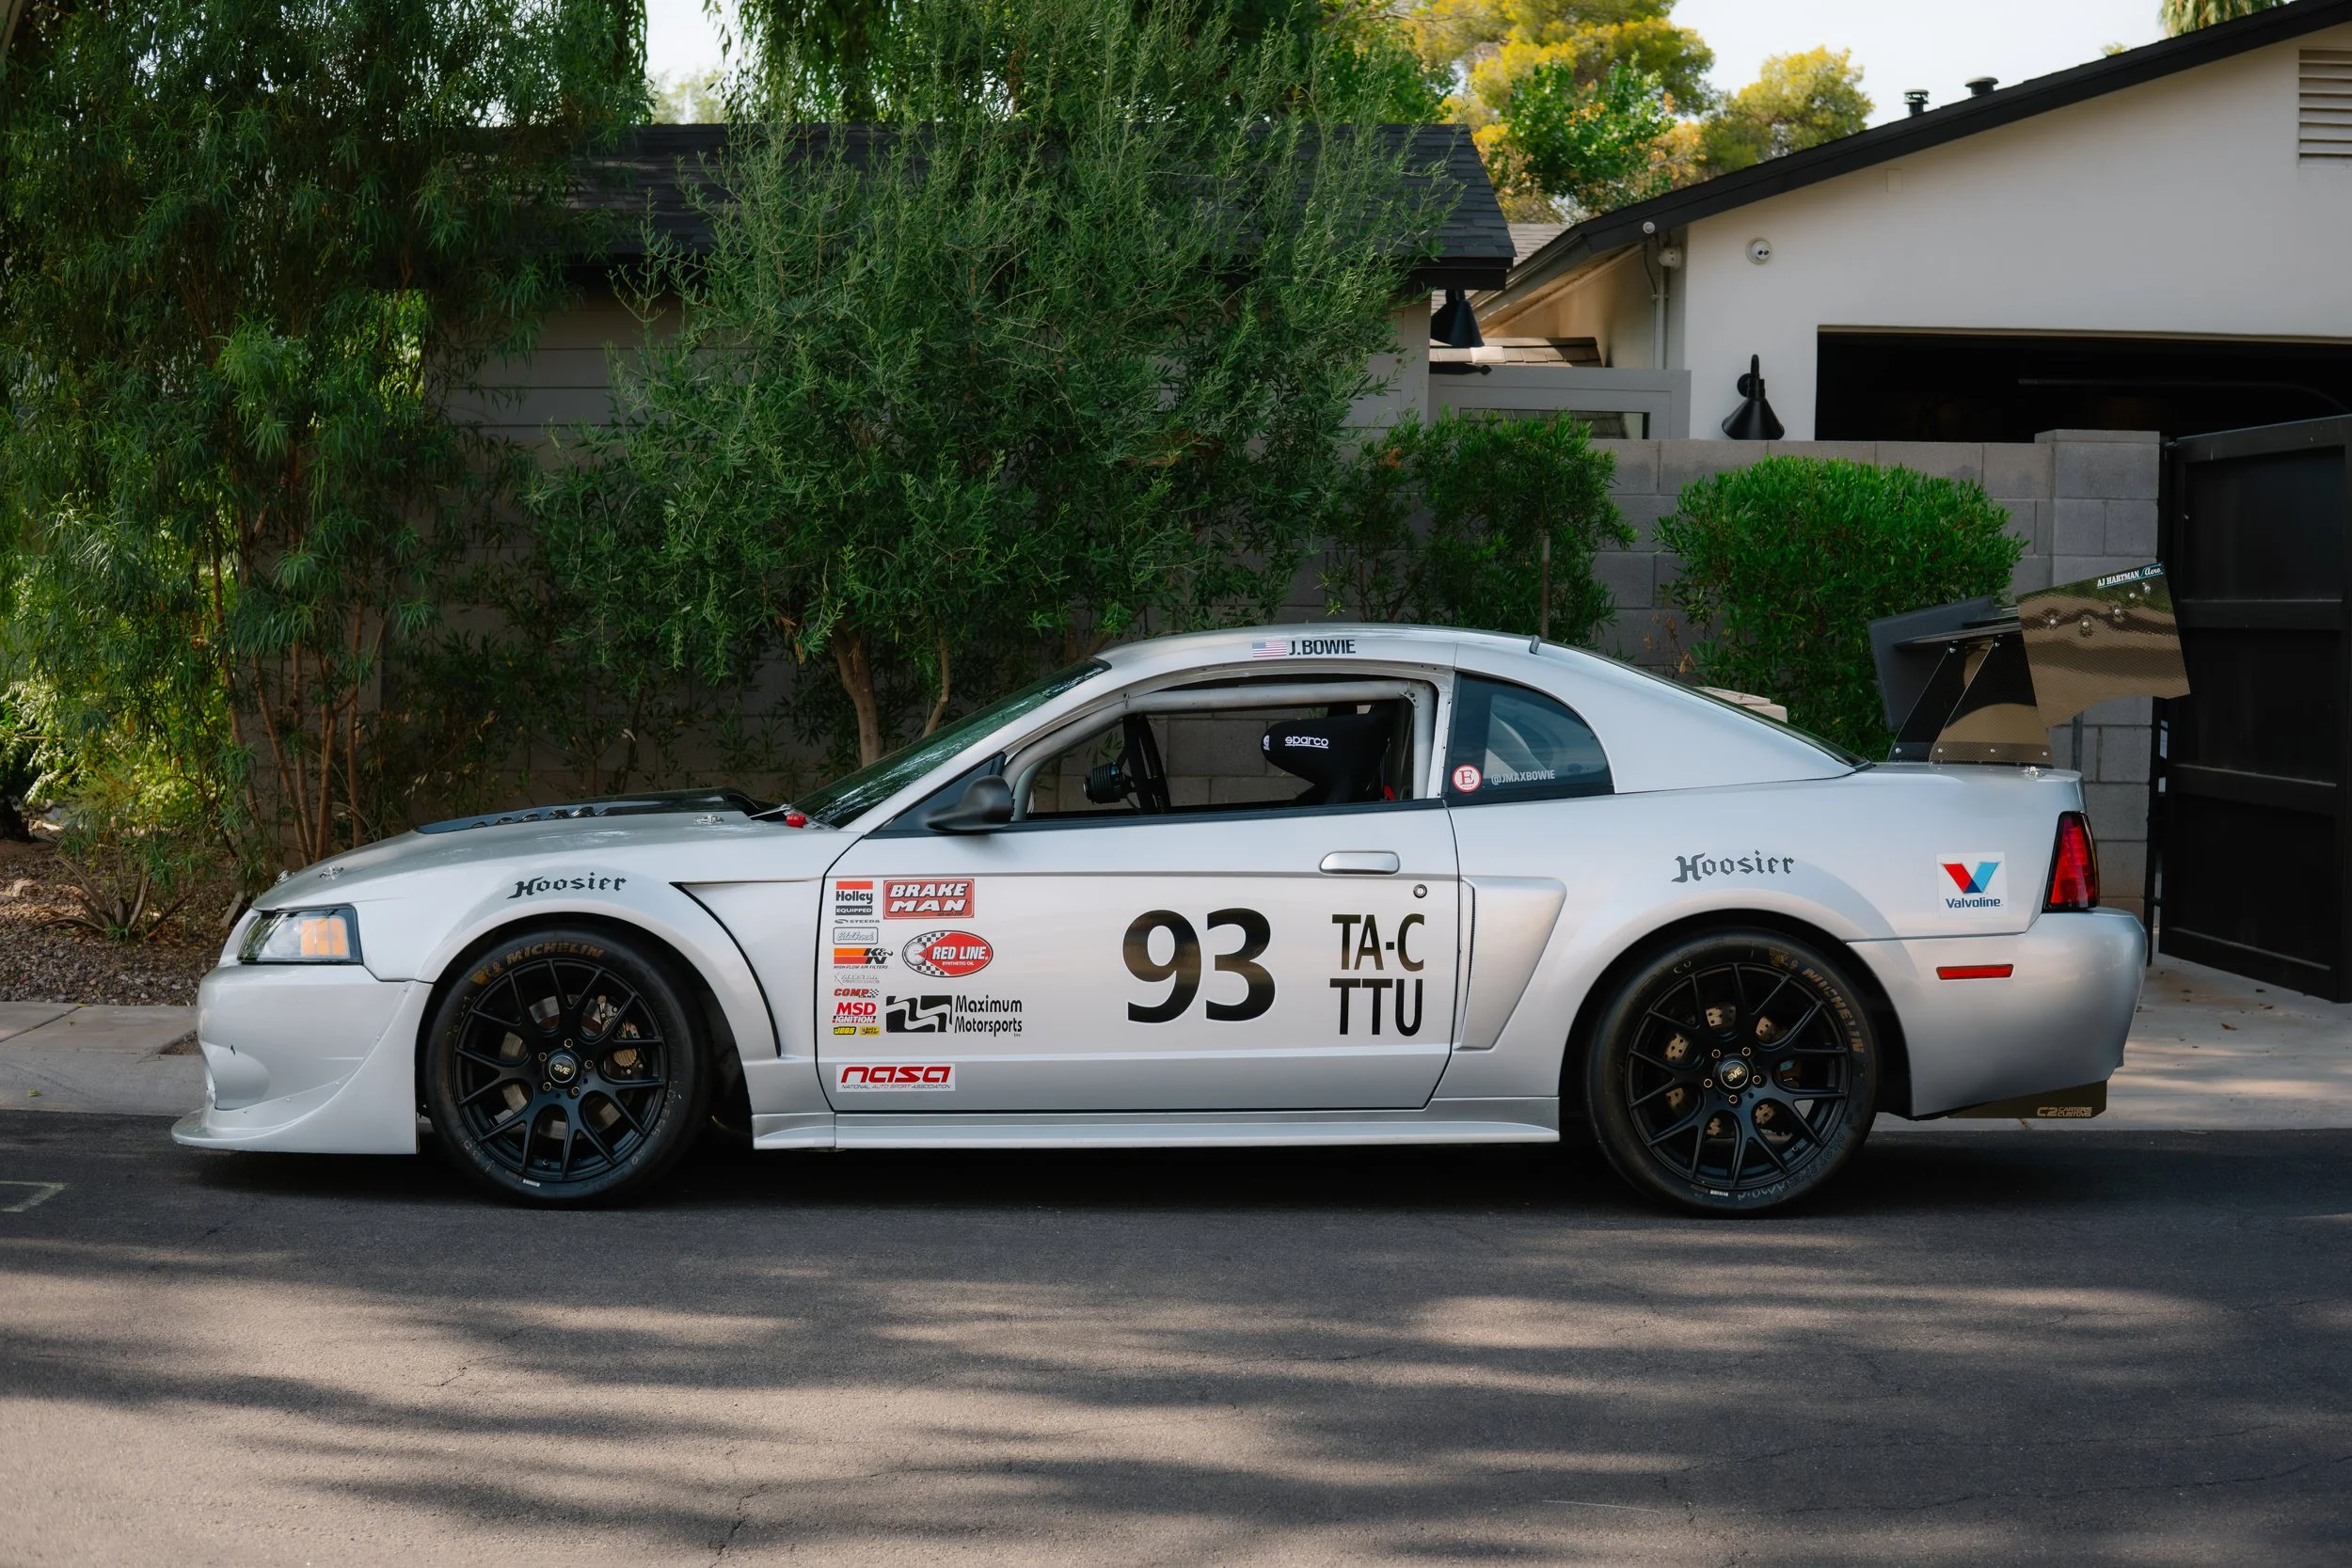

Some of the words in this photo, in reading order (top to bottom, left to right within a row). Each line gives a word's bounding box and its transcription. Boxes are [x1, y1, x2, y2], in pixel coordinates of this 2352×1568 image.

[2097, 578, 2106, 588] AJ
[2106, 571, 2139, 584] HARTMAN
[1289, 639, 1356, 656] J.BOWIE
[1284, 736, 1329, 748] sparco
[1491, 769, 1556, 785] @JMAXBOWIE
[1671, 849, 1795, 883] Hoosier
[506, 871, 627, 899] Hoosier
[889, 883, 969, 898] BRAKE
[835, 890, 874, 905] Holley
[1946, 896, 2001, 909] Valvoline
[889, 899, 967, 913] MAN
[1331, 912, 1425, 973] TA-C
[506, 942, 604, 964] MICHELIN
[931, 945, 957, 960] RED
[959, 945, 987, 960] LINE
[1122, 908, 1277, 1023] 93
[834, 988, 870, 997] COMP
[835, 1002, 877, 1016] MSD
[955, 994, 1023, 1013] Maximum
[1329, 977, 1423, 1037] TTU
[1801, 967, 1865, 1053] MICHELIN
[954, 1016, 1023, 1037] Motorsports
[554, 1064, 571, 1075] SVE
[840, 1066, 952, 1084] nasa
[1727, 1067, 1742, 1082] SVE
[2037, 1106, 2058, 1117] C2
